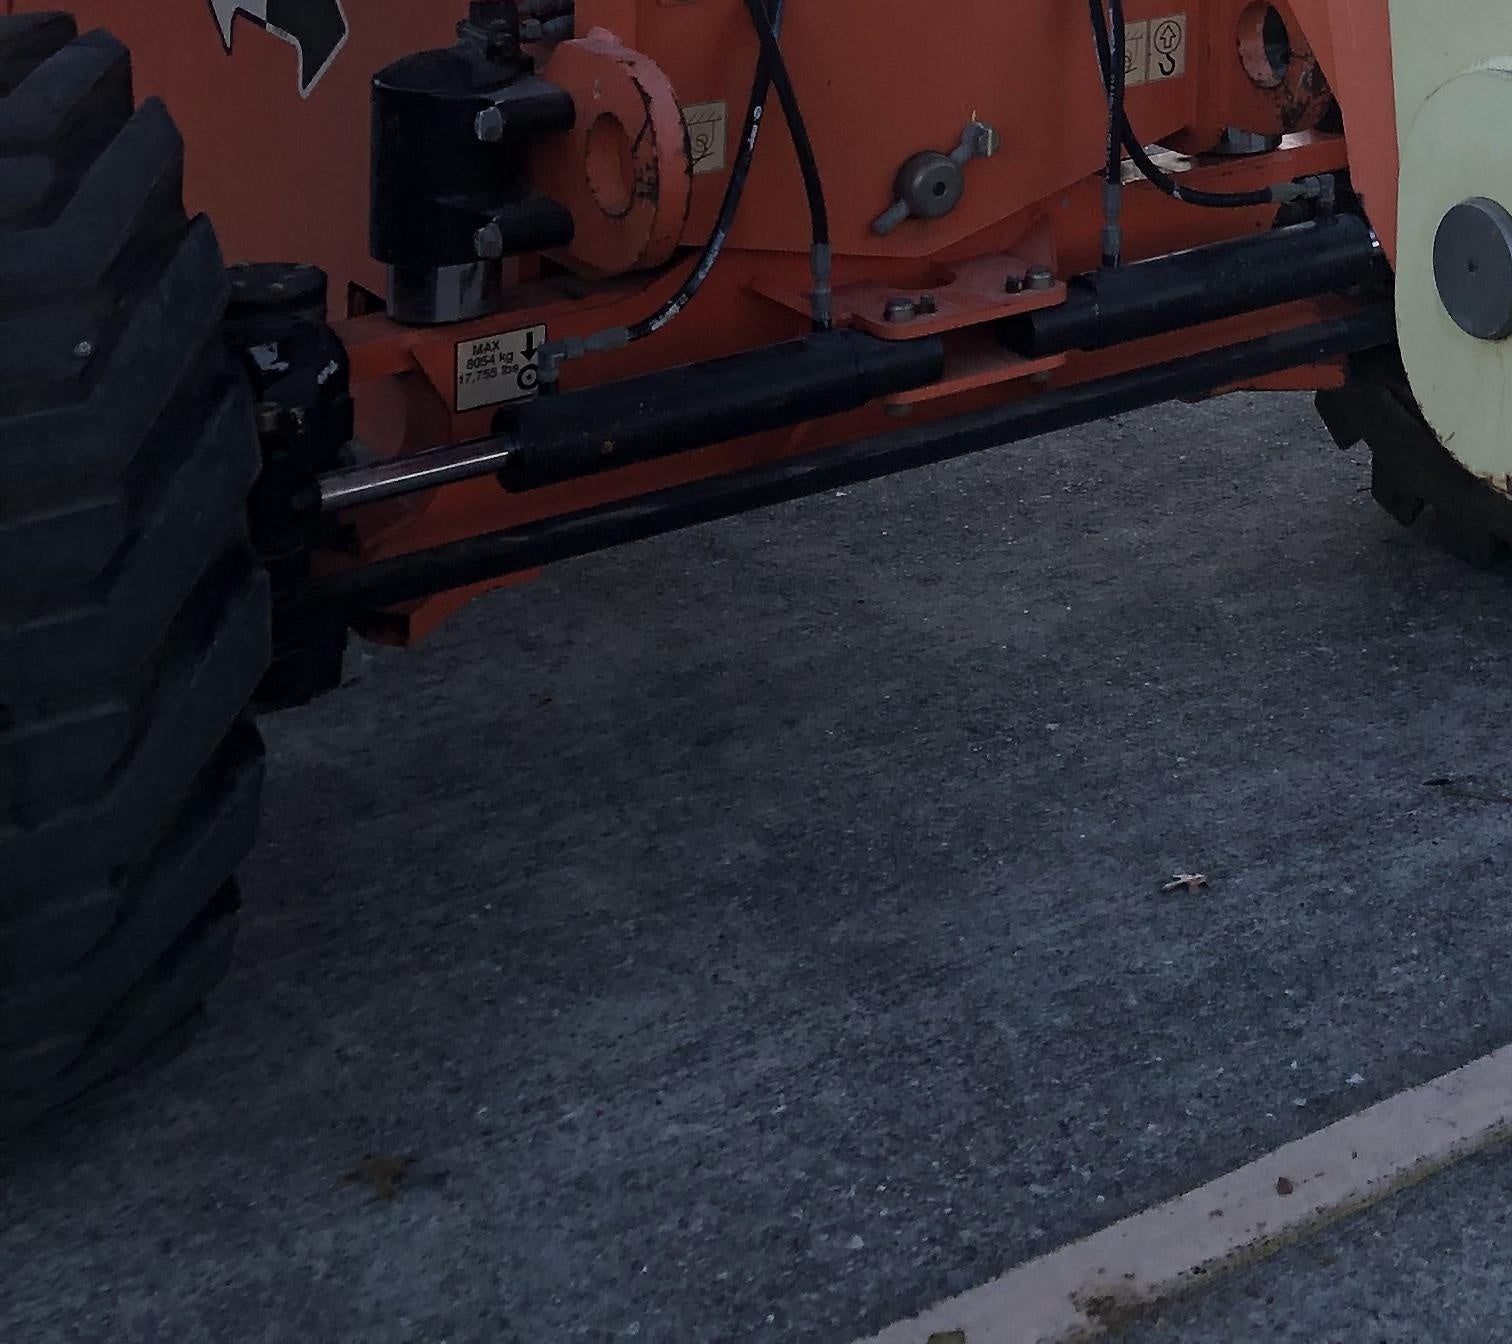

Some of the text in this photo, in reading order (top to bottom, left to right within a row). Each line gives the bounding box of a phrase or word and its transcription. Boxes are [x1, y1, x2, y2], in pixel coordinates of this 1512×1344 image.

[472, 339, 500, 356] MAX
[499, 351, 514, 364] kg
[501, 363, 519, 376] lbs
